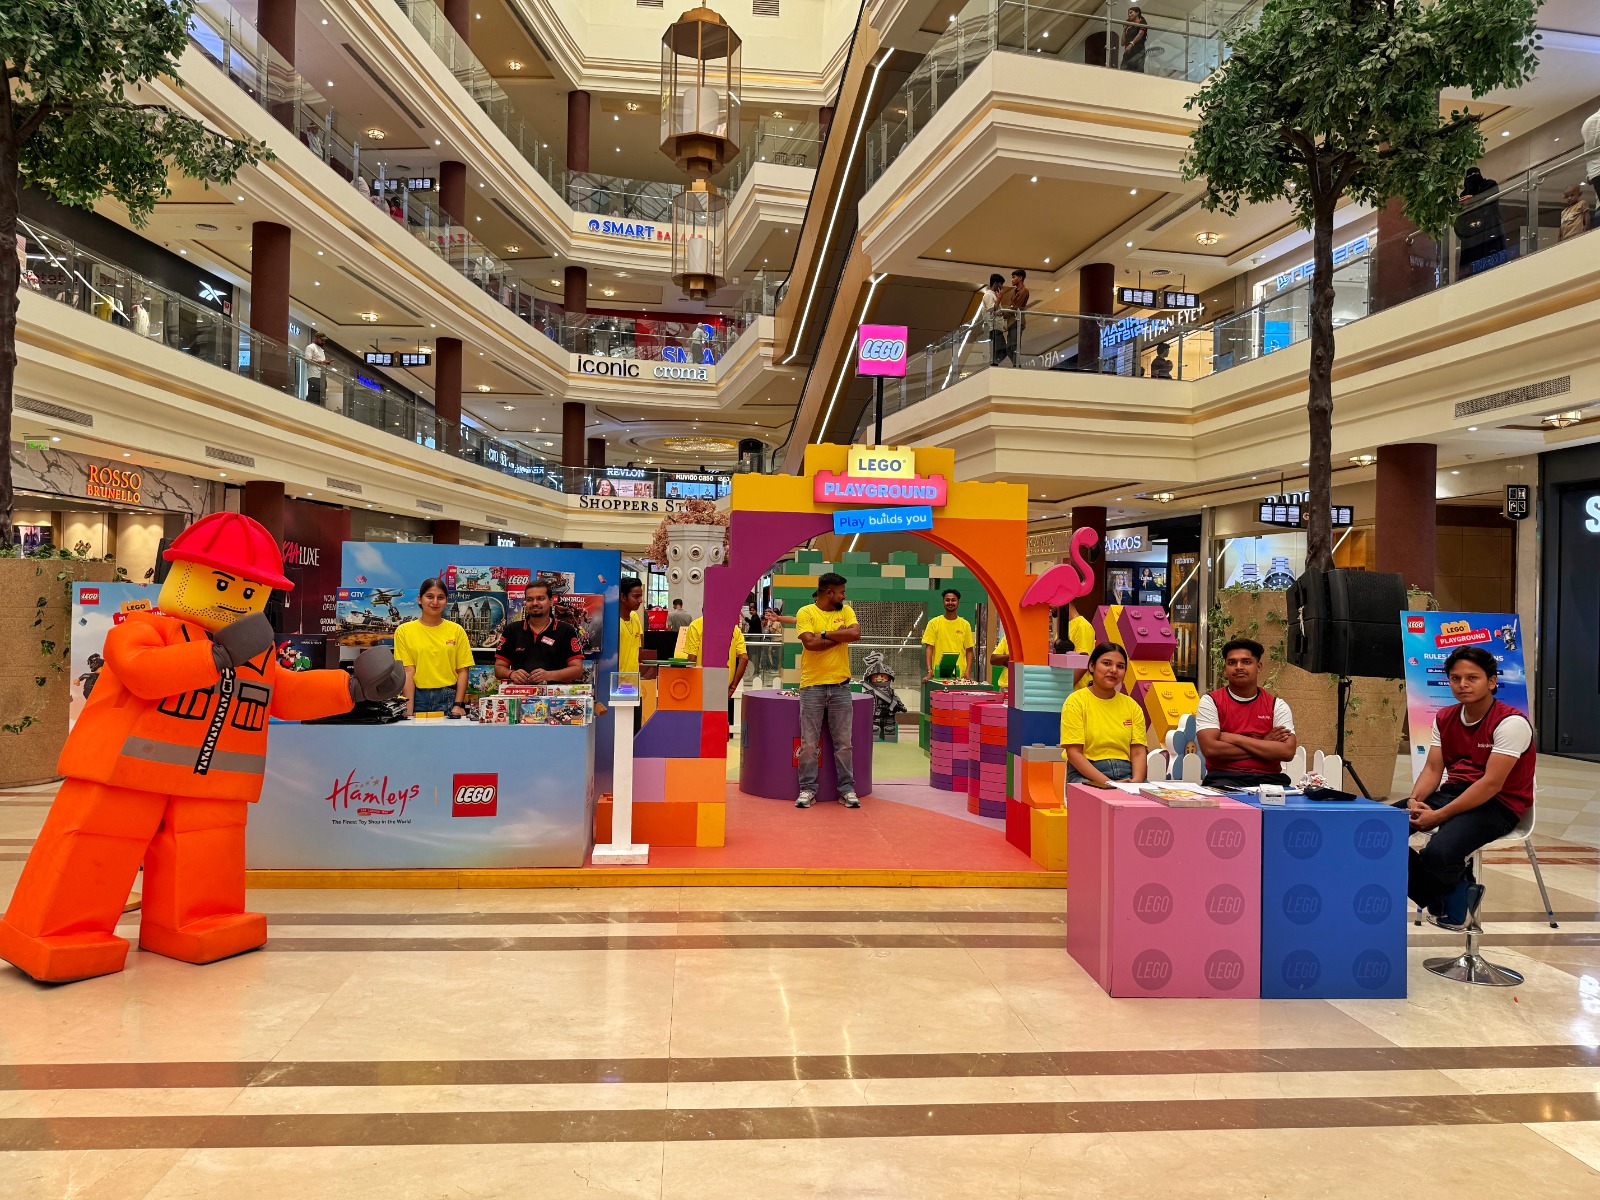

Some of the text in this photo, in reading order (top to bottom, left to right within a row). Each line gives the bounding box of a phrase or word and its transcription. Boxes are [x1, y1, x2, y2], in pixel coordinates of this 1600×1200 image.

[602, 220, 655, 240] SMART
[861, 338, 905, 361] LEGO
[577, 355, 640, 377] iconic
[89, 464, 142, 490] ROSSO
[606, 467, 645, 478] REVLON
[87, 484, 141, 503] BRUNELLO
[824, 482, 938, 499] PLAYGROUND
[579, 495, 659, 512] SHOPPERS
[839, 512, 927, 528] Play builds you
[299, 546, 320, 566] LUXE
[508, 575, 530, 586] LEGO
[81, 592, 98, 600] LEGO
[126, 603, 146, 611] LEGO
[322, 603, 336, 611] OPEN
[571, 637, 581, 653] 6
[1440, 633, 1486, 645] PLAYGROUND
[325, 767, 421, 817] Hamleys
[454, 785, 496, 804] LEGO
[1138, 829, 1170, 846] LEGO
[1210, 830, 1242, 848] LEGO
[1287, 830, 1319, 848] LEGO
[1358, 830, 1390, 848] LEGO
[1137, 895, 1170, 913] LEGO
[1209, 896, 1241, 914] LEGO
[1287, 896, 1318, 914] LEGO
[1357, 896, 1389, 914] LEGO
[1136, 961, 1169, 979] LEGO
[1208, 962, 1241, 980] LEGO
[1286, 962, 1318, 980] LEGO
[1356, 961, 1389, 979] LEGO
